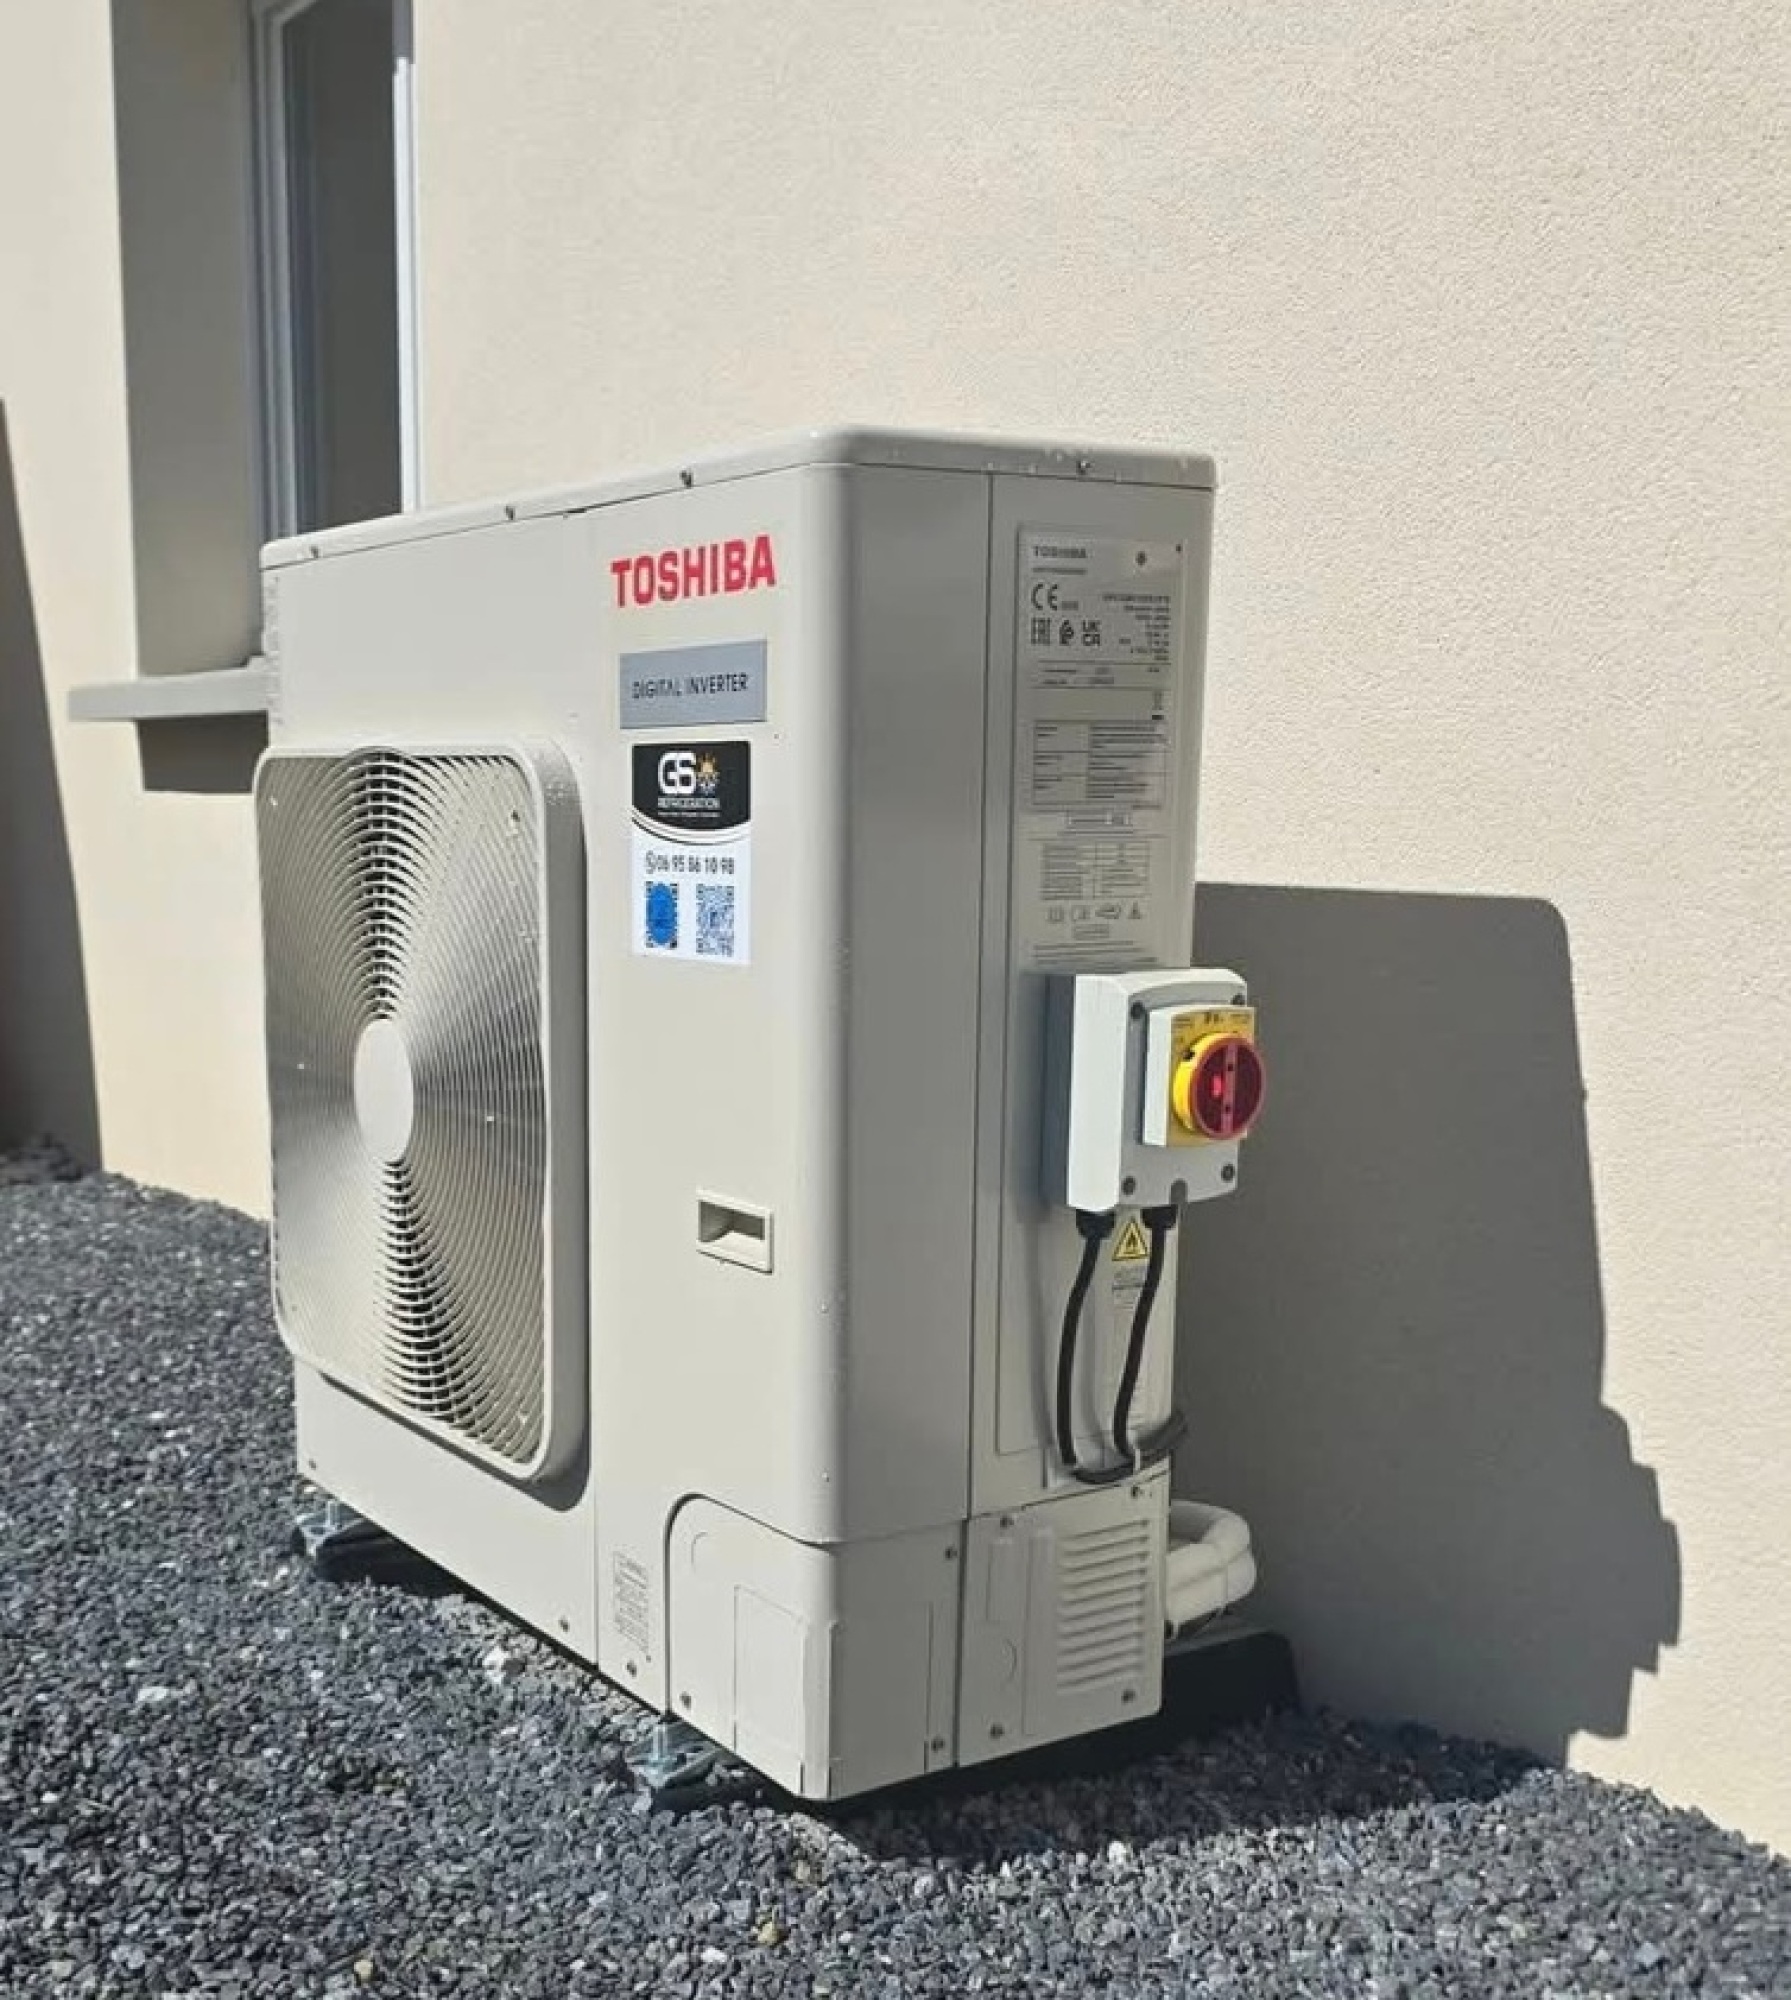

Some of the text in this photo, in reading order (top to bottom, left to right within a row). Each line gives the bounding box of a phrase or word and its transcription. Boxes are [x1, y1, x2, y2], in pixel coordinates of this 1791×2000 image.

[610, 533, 777, 608] TOSHIBA
[632, 672, 749, 699] DIGITAL INVERTER
[672, 855, 685, 872] 95
